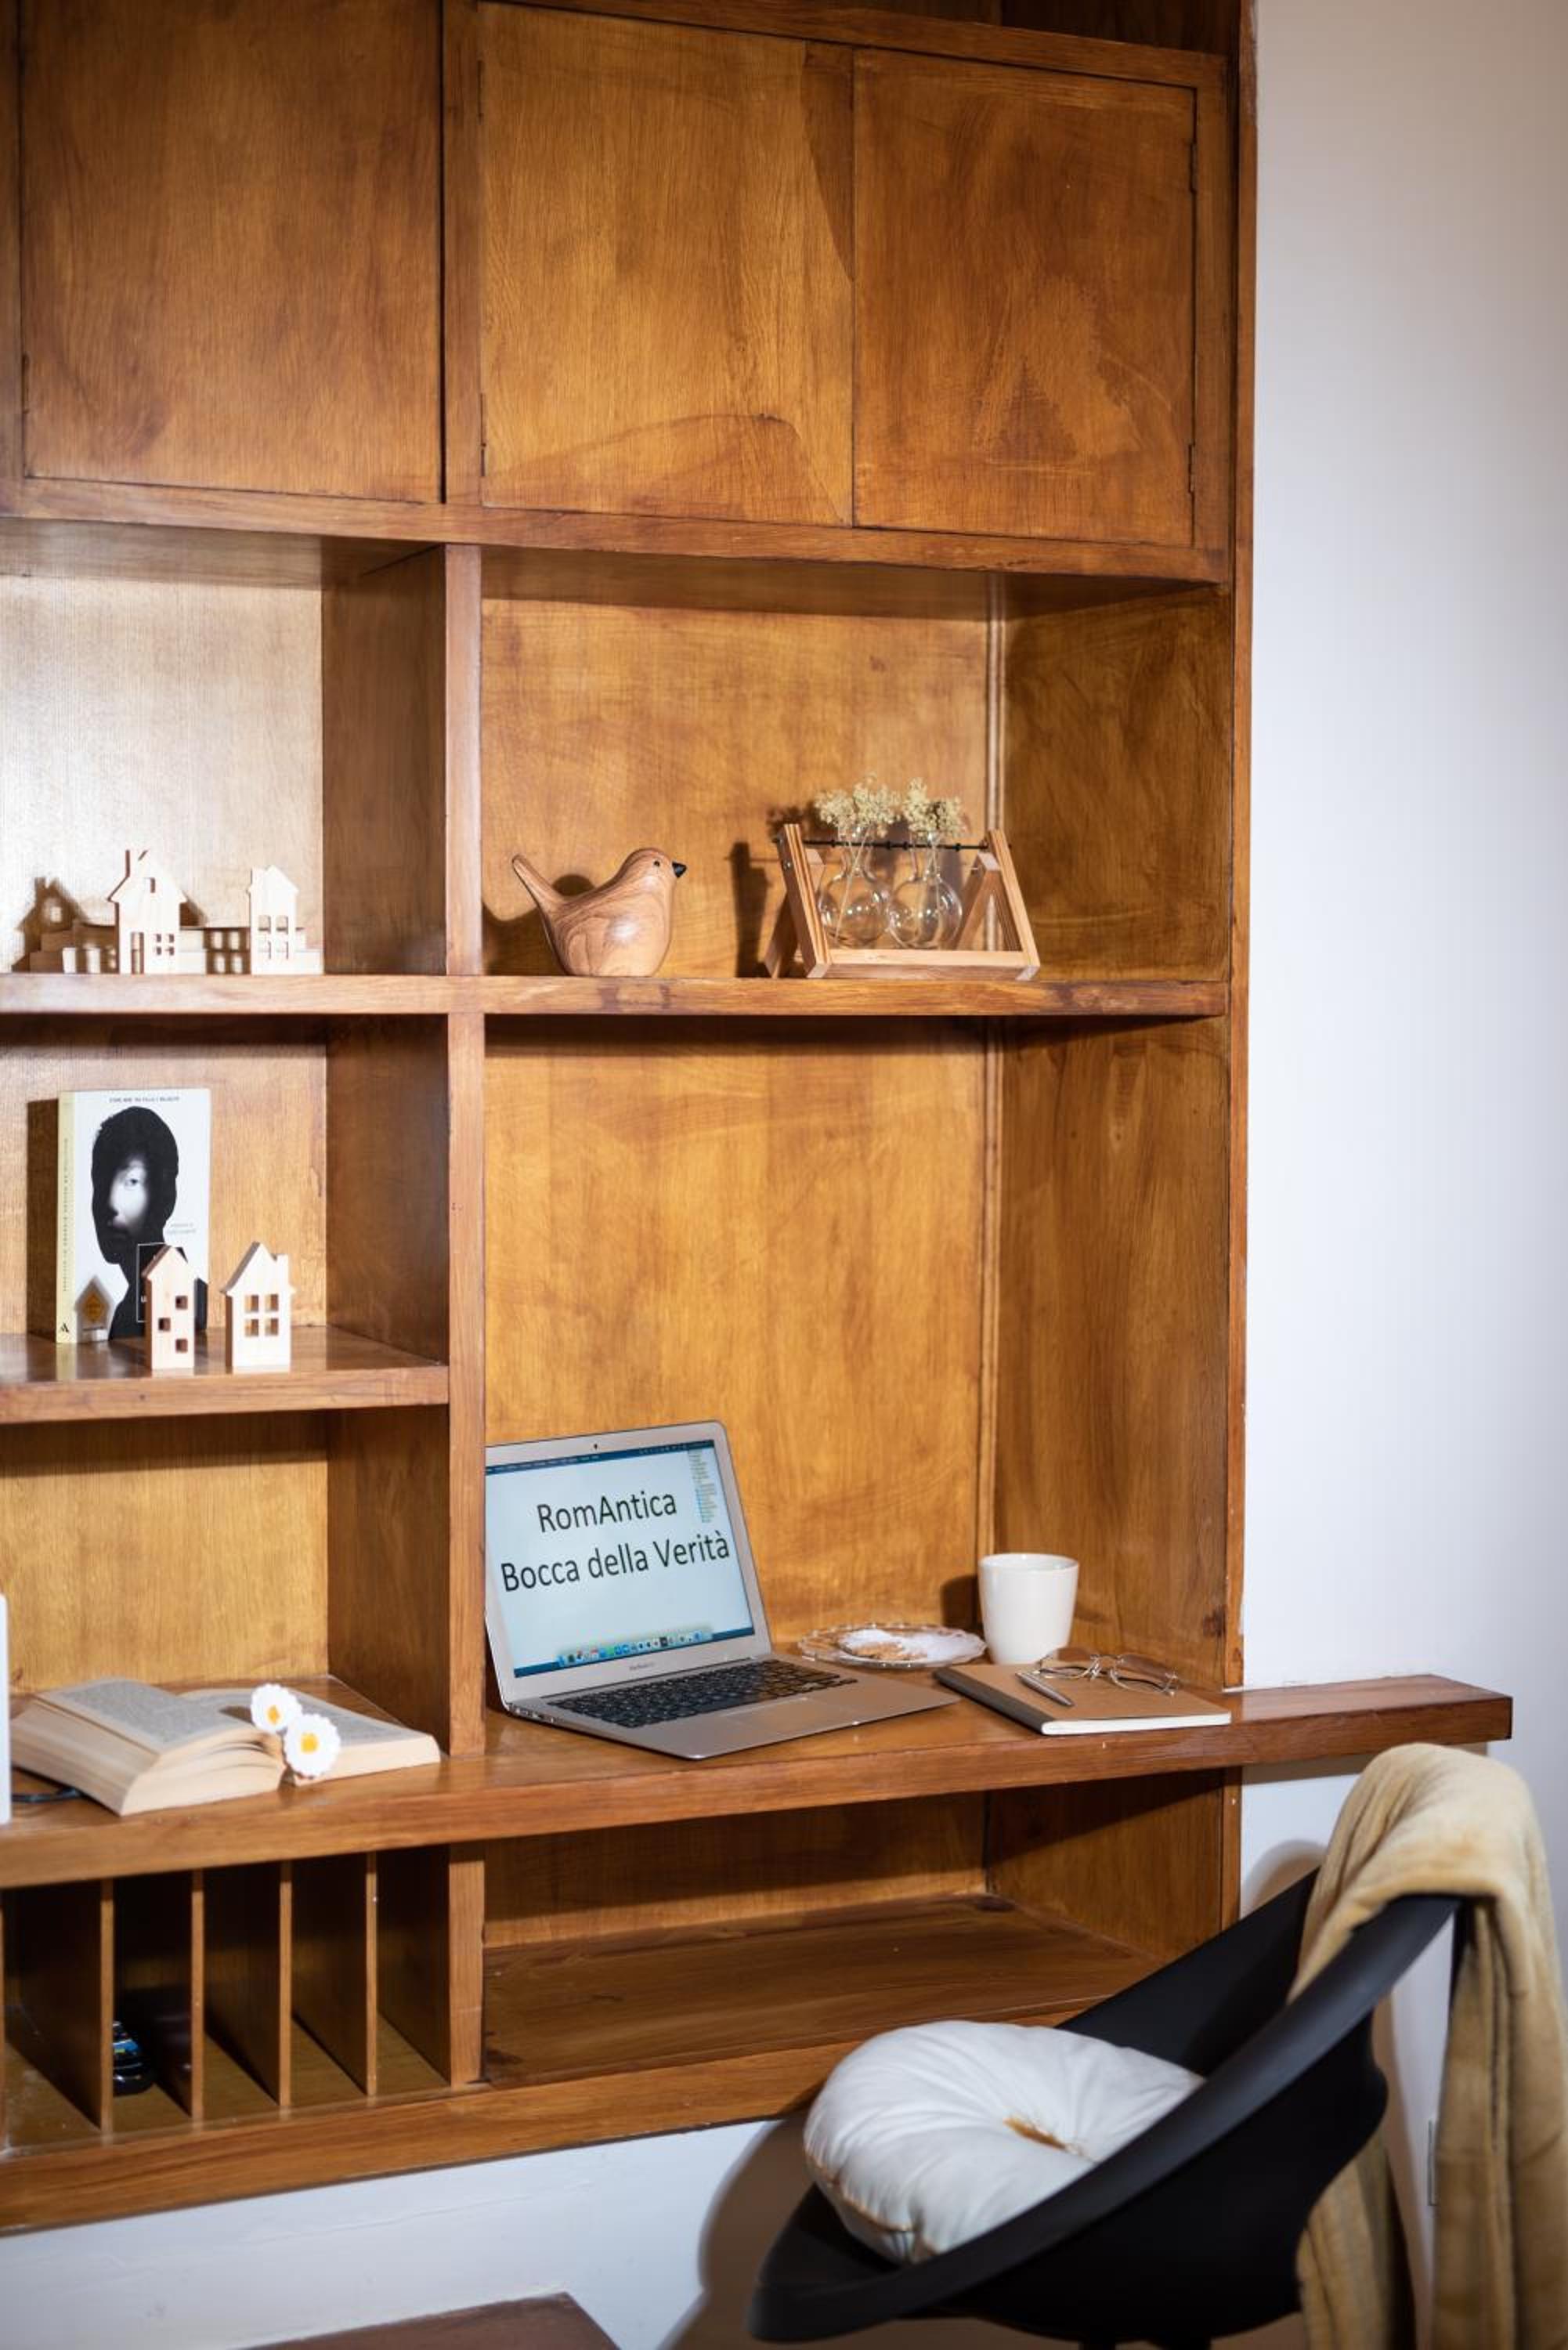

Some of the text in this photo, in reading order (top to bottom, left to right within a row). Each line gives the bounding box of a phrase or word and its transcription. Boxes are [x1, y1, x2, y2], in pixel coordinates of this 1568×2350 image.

[537, 1491, 677, 1532] RomAntica
[500, 1530, 730, 1592] Bocca della Verità
